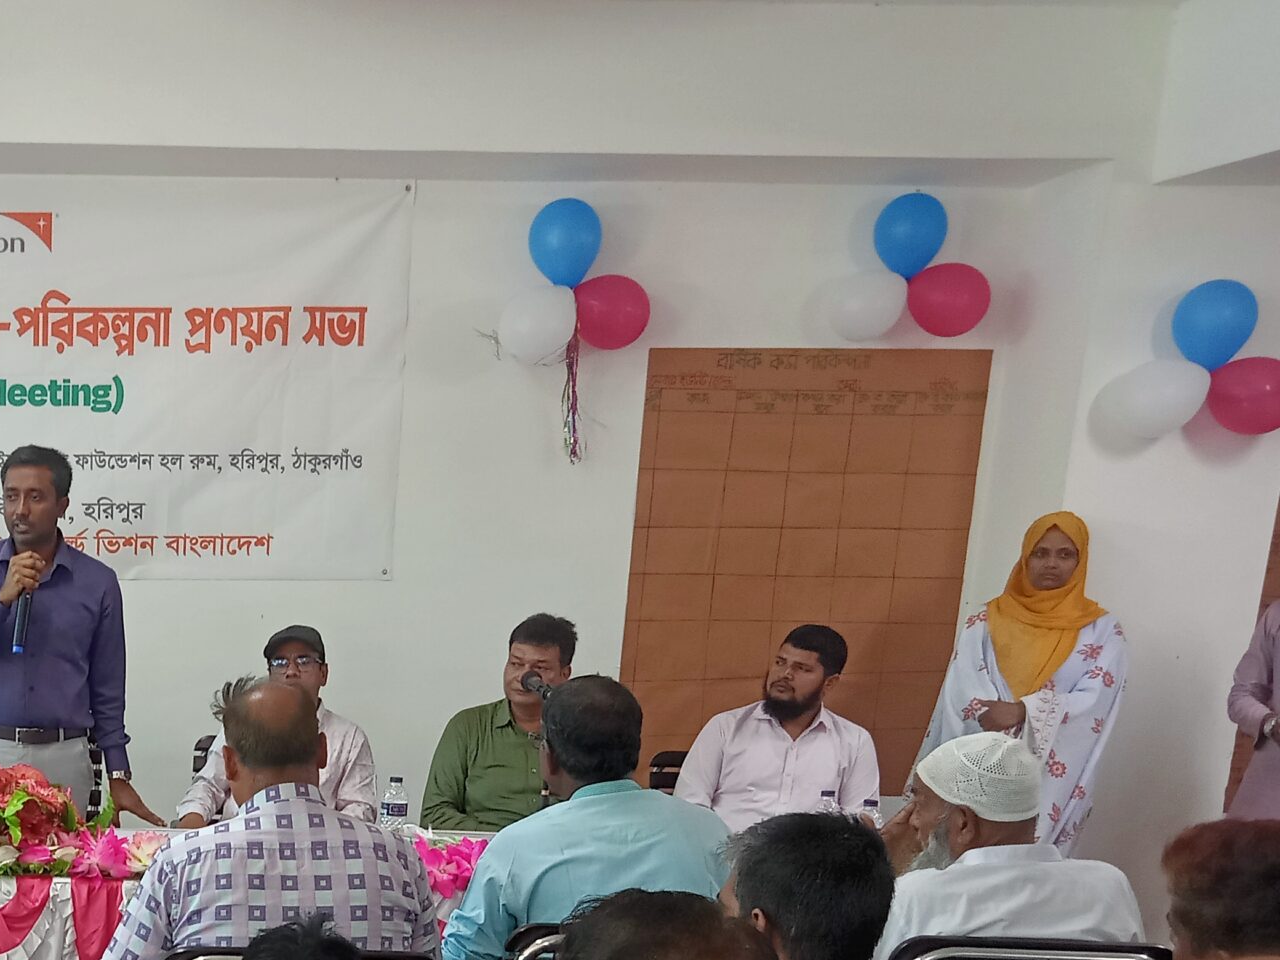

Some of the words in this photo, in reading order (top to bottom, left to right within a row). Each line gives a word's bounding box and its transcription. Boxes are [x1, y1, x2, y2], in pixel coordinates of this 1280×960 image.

[184, 305, 293, 354] প্রণয়ন
[302, 305, 368, 348] সভা
[73, 448, 154, 471] ফাউন্ডেশন
[158, 454, 184, 472] হল
[189, 453, 222, 474] রুম,
[228, 448, 286, 474] হরিপুর,
[291, 446, 363, 475] ঠাকুরগাঁও
[82, 496, 147, 525] হরিপুর
[94, 528, 158, 557] ভিশন
[164, 532, 274, 558] বাংলাদেশ
